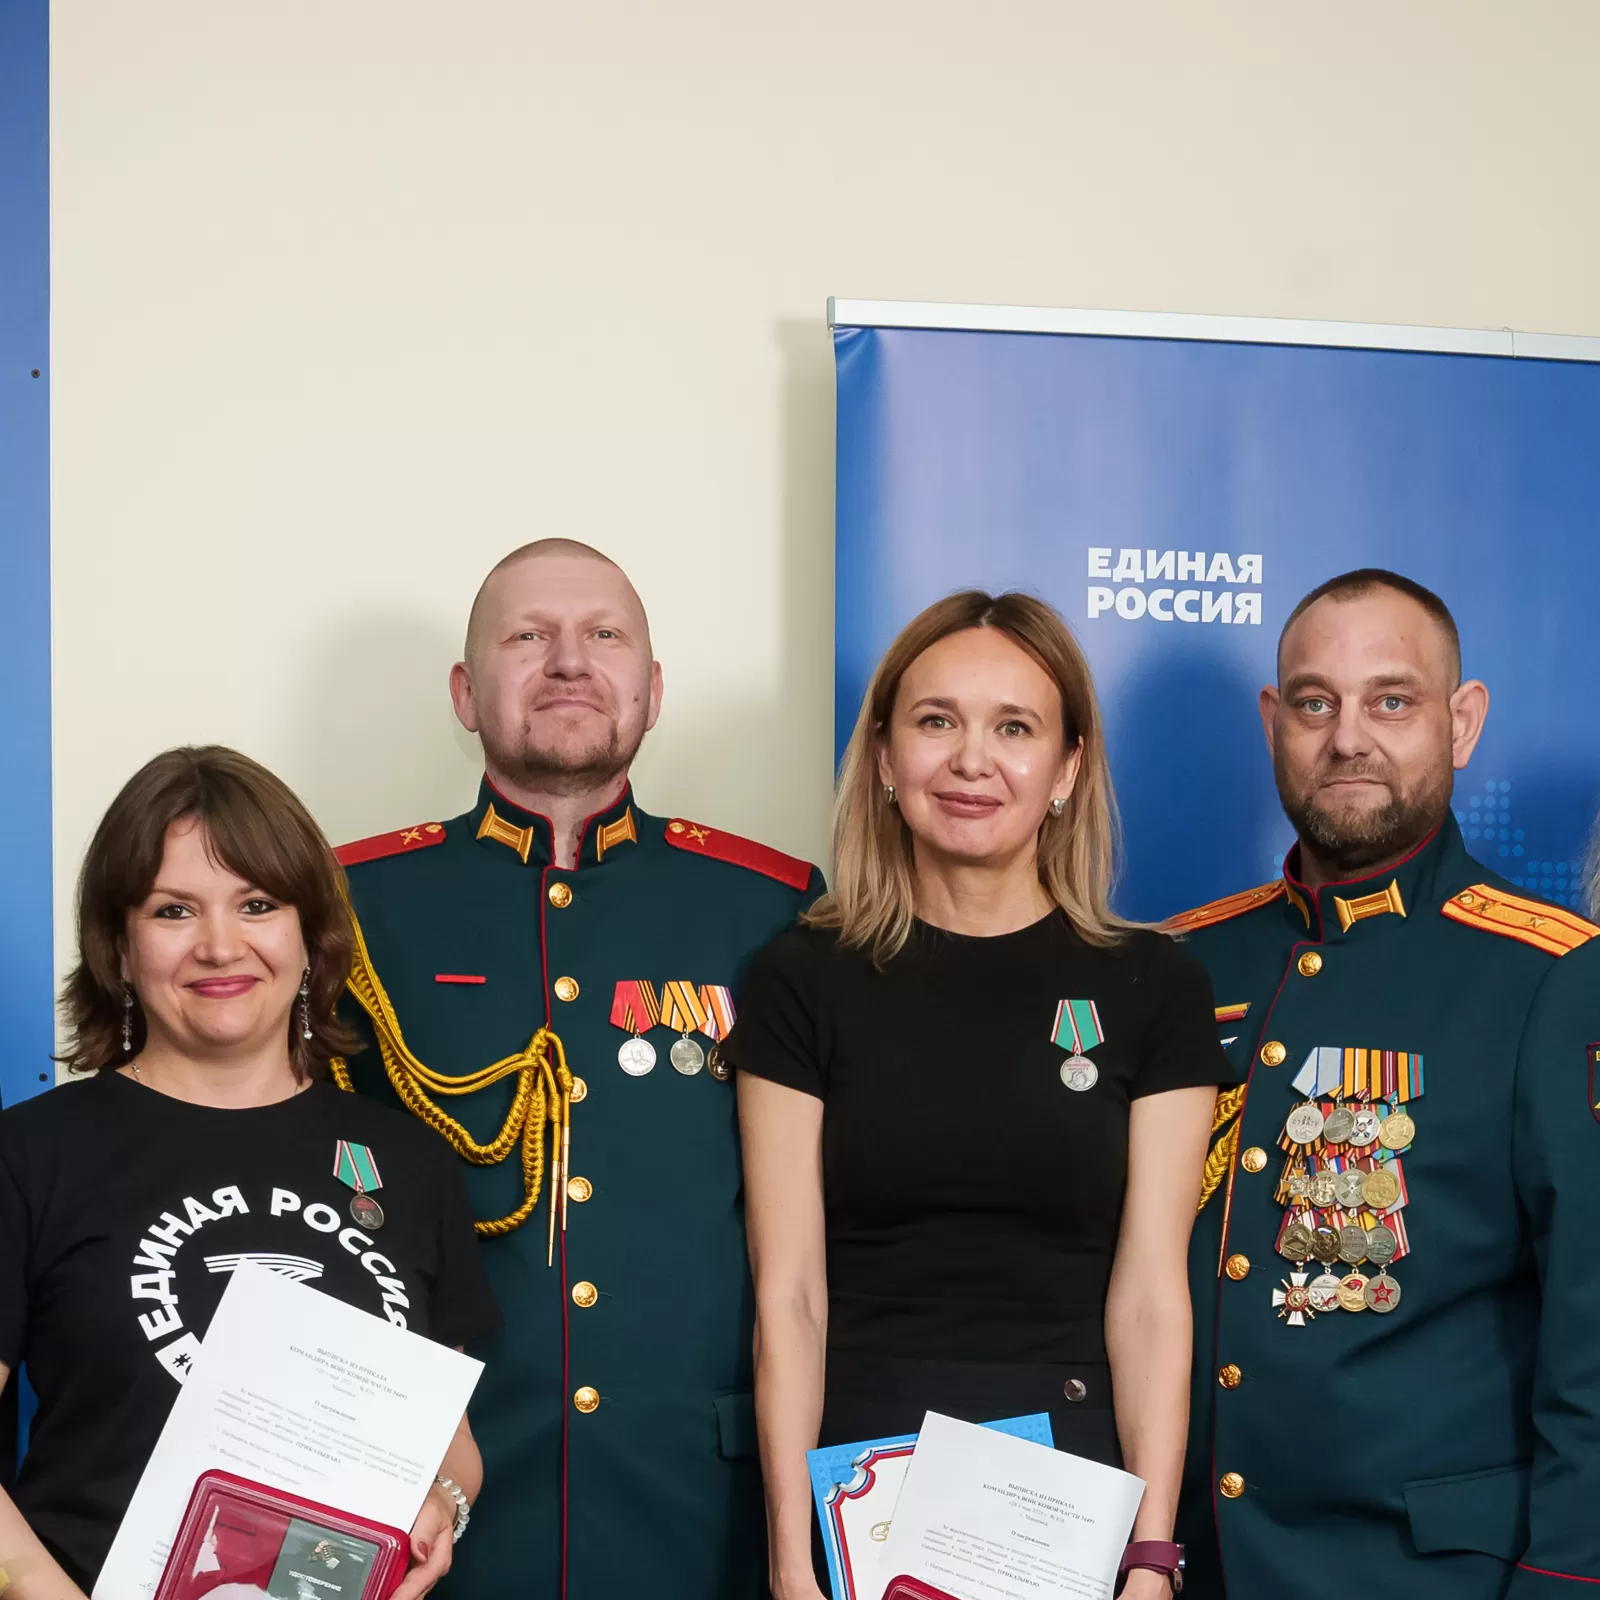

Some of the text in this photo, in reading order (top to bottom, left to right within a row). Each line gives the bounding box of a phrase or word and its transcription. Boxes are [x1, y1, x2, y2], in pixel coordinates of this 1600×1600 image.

[1088, 548, 1262, 584] ЕДИНАЯ
[1088, 586, 1262, 624] РОССИЯ
[131, 1185, 410, 1341] ЕДИНАЯ РОССИЯ
